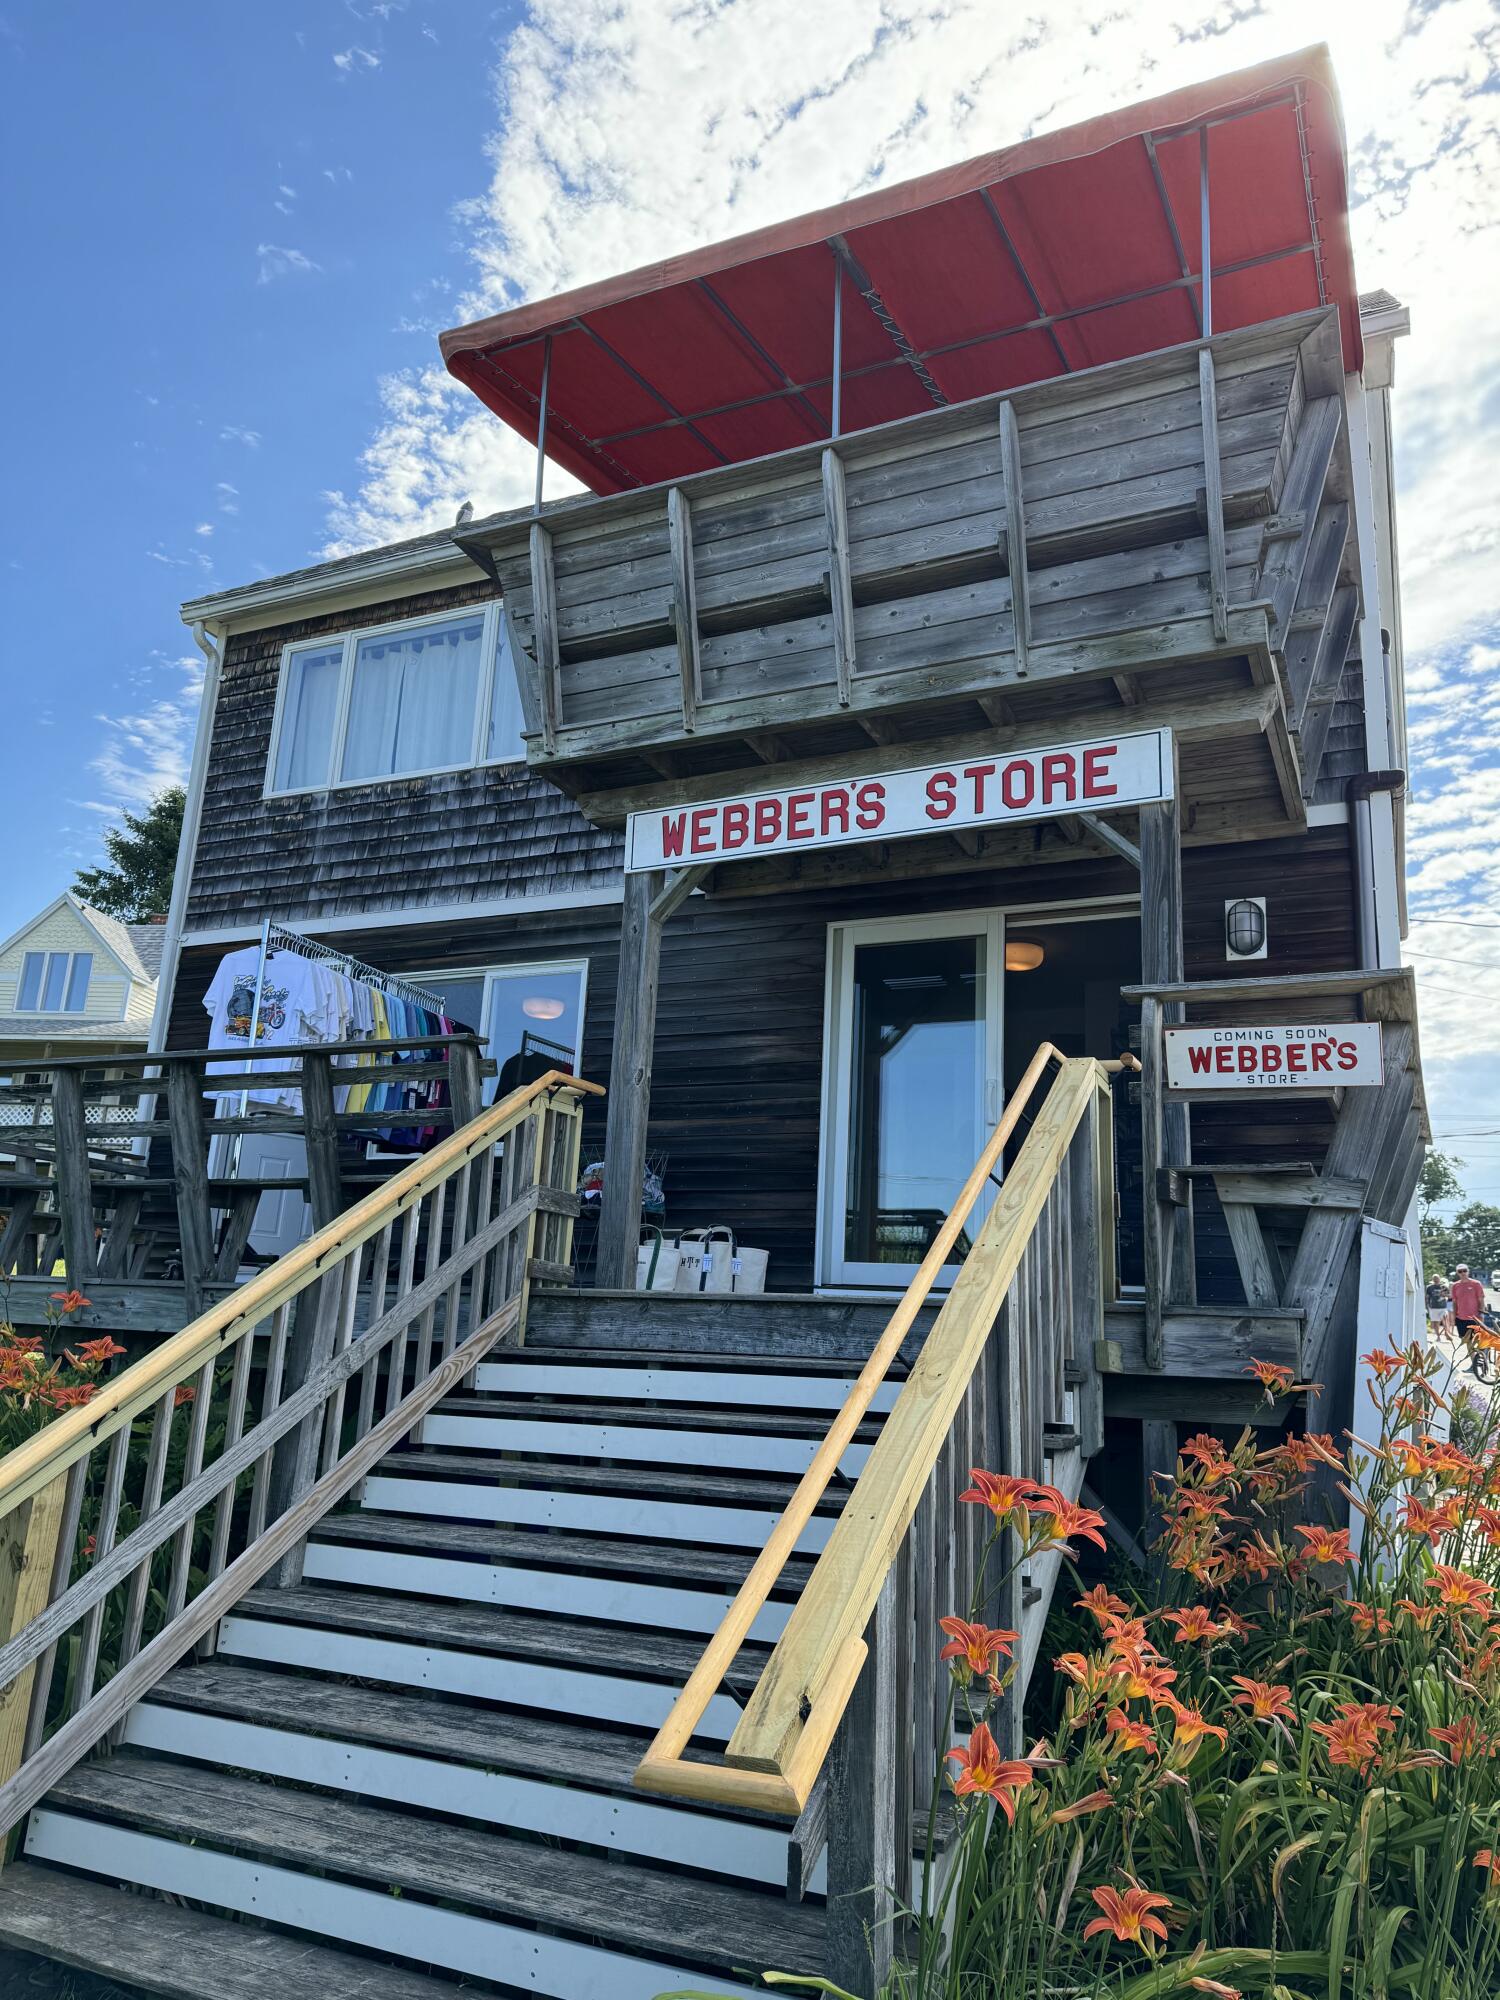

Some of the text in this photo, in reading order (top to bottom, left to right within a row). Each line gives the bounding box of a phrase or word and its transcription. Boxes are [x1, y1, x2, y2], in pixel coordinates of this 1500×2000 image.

[662, 745, 1117, 857] WEBBER'S STORE
[1213, 1028, 1328, 1042] COMING SOON
[1188, 1037, 1358, 1073] WEBBER'S
[1247, 1073, 1298, 1084] STORE
